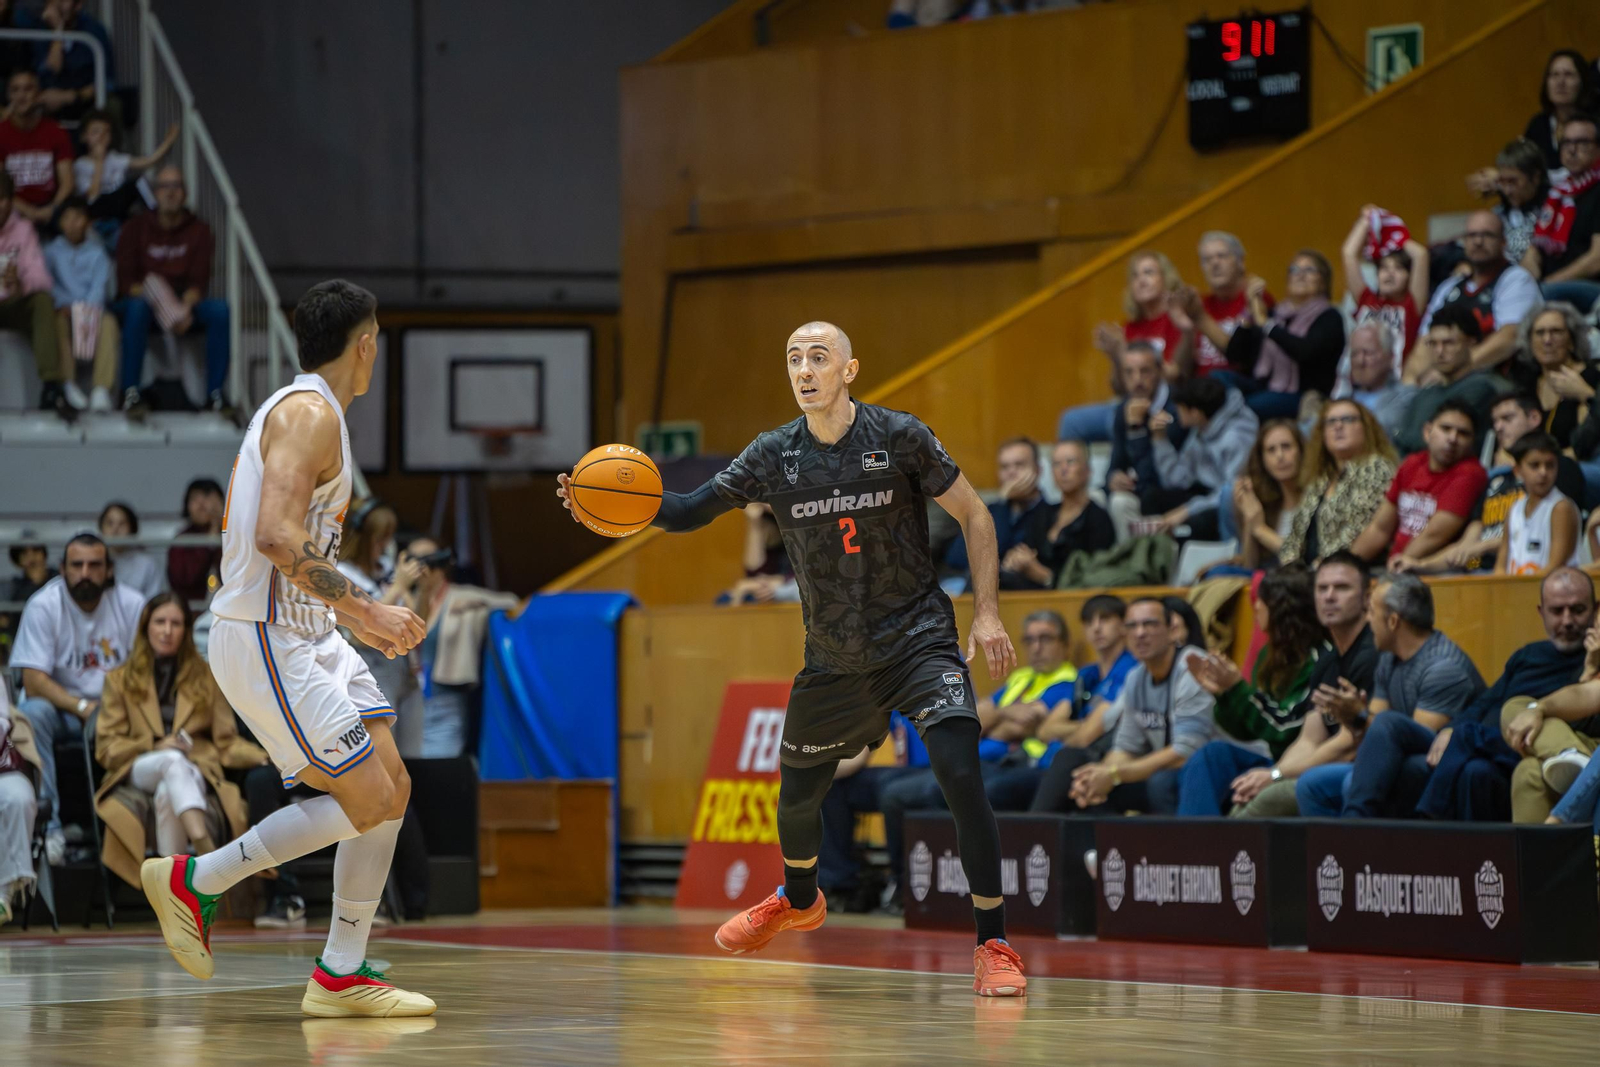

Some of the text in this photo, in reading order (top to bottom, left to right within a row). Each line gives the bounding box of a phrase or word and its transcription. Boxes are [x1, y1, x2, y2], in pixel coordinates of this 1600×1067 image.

[781, 448, 801, 458] vive
[838, 517, 861, 554] 2
[782, 739, 797, 751] vive
[1413, 875, 1463, 916] GIRONA
